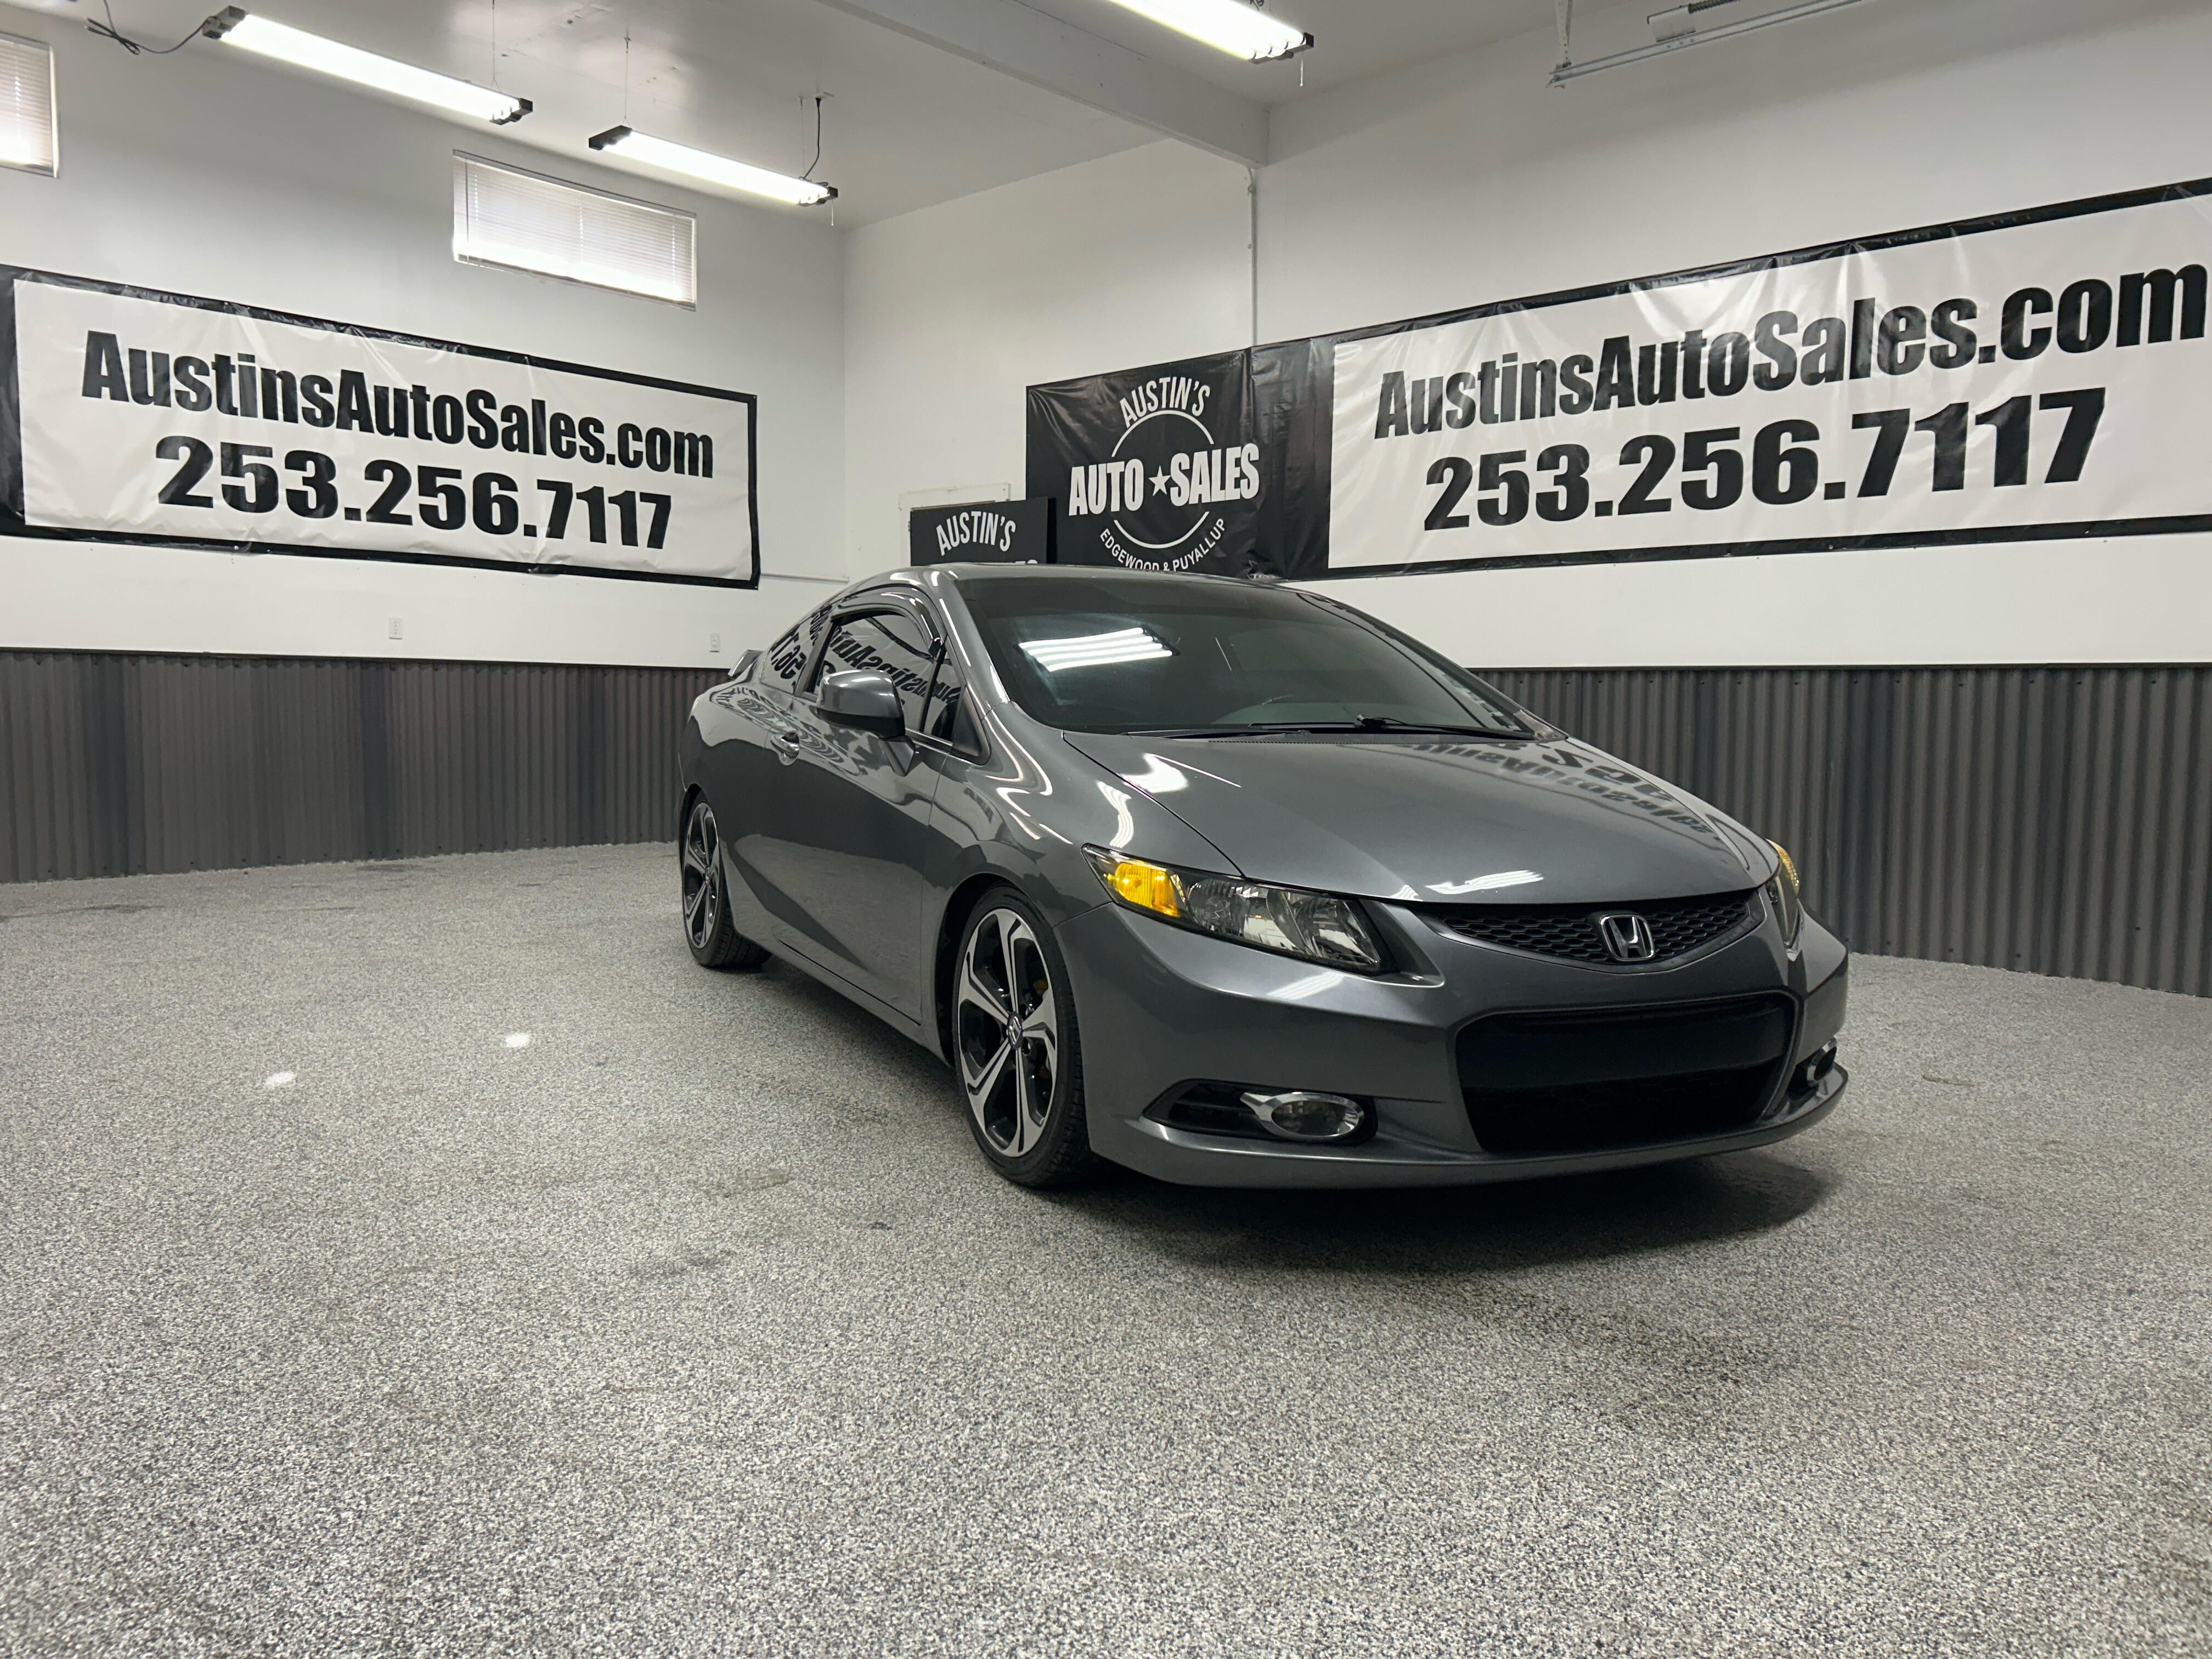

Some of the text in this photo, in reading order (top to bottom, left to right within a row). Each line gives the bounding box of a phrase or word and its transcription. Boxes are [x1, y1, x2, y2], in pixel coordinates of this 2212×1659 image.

[1373, 263, 2208, 439] AustinsAutoSales.com
[82, 330, 713, 479] AustinsAutoSales.com
[1119, 376, 1211, 428] AUSTIN'S
[156, 436, 672, 549] 253.256.7117
[1068, 443, 1260, 516] AUTO SALES
[1424, 387, 2106, 531] 253.256.7117
[935, 510, 1017, 556] AUSTIN'S
[1100, 528, 1160, 571] EDGEWOOD
[1172, 518, 1225, 572] PUYALLUP
